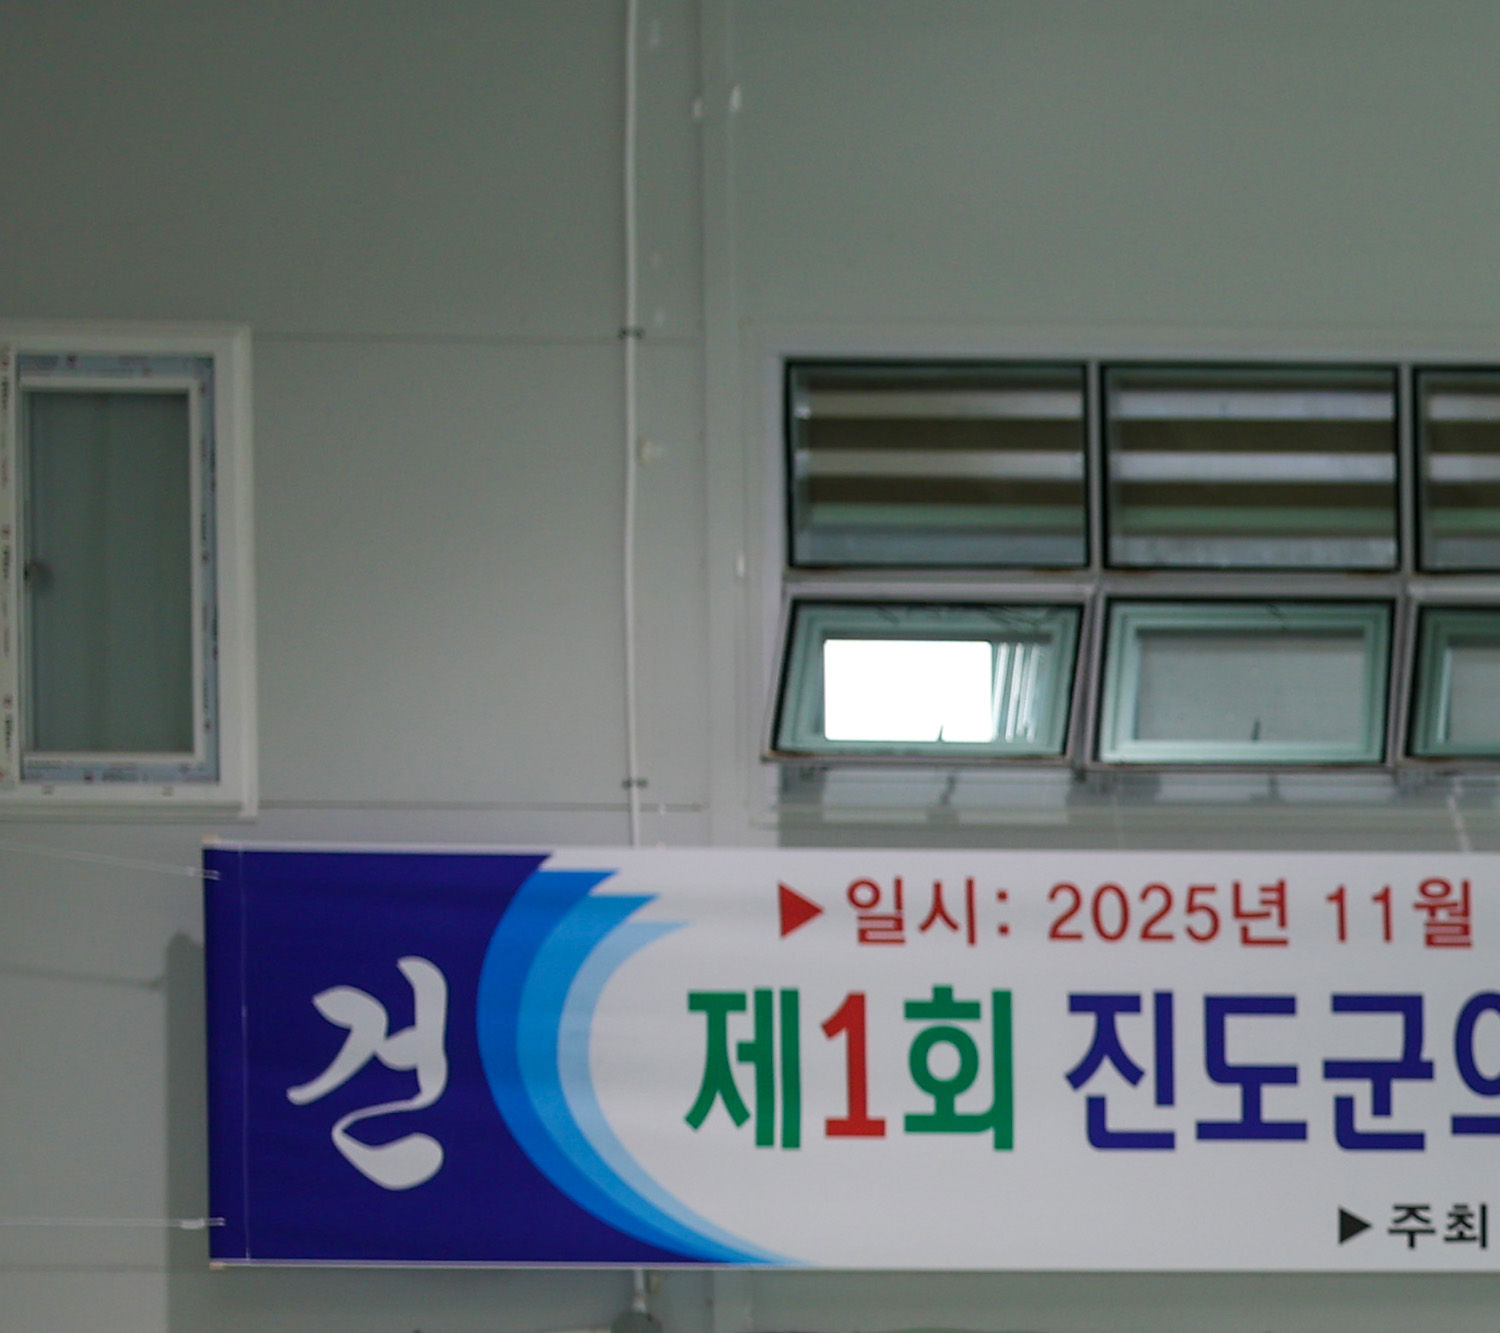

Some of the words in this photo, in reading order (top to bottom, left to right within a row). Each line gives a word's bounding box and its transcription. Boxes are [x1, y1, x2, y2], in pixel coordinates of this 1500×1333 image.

[847, 878, 1010, 947] 일시:
[1047, 879, 1290, 948] 2025년
[1325, 877, 1474, 950] 11월
[683, 983, 1015, 1153] 제1회
